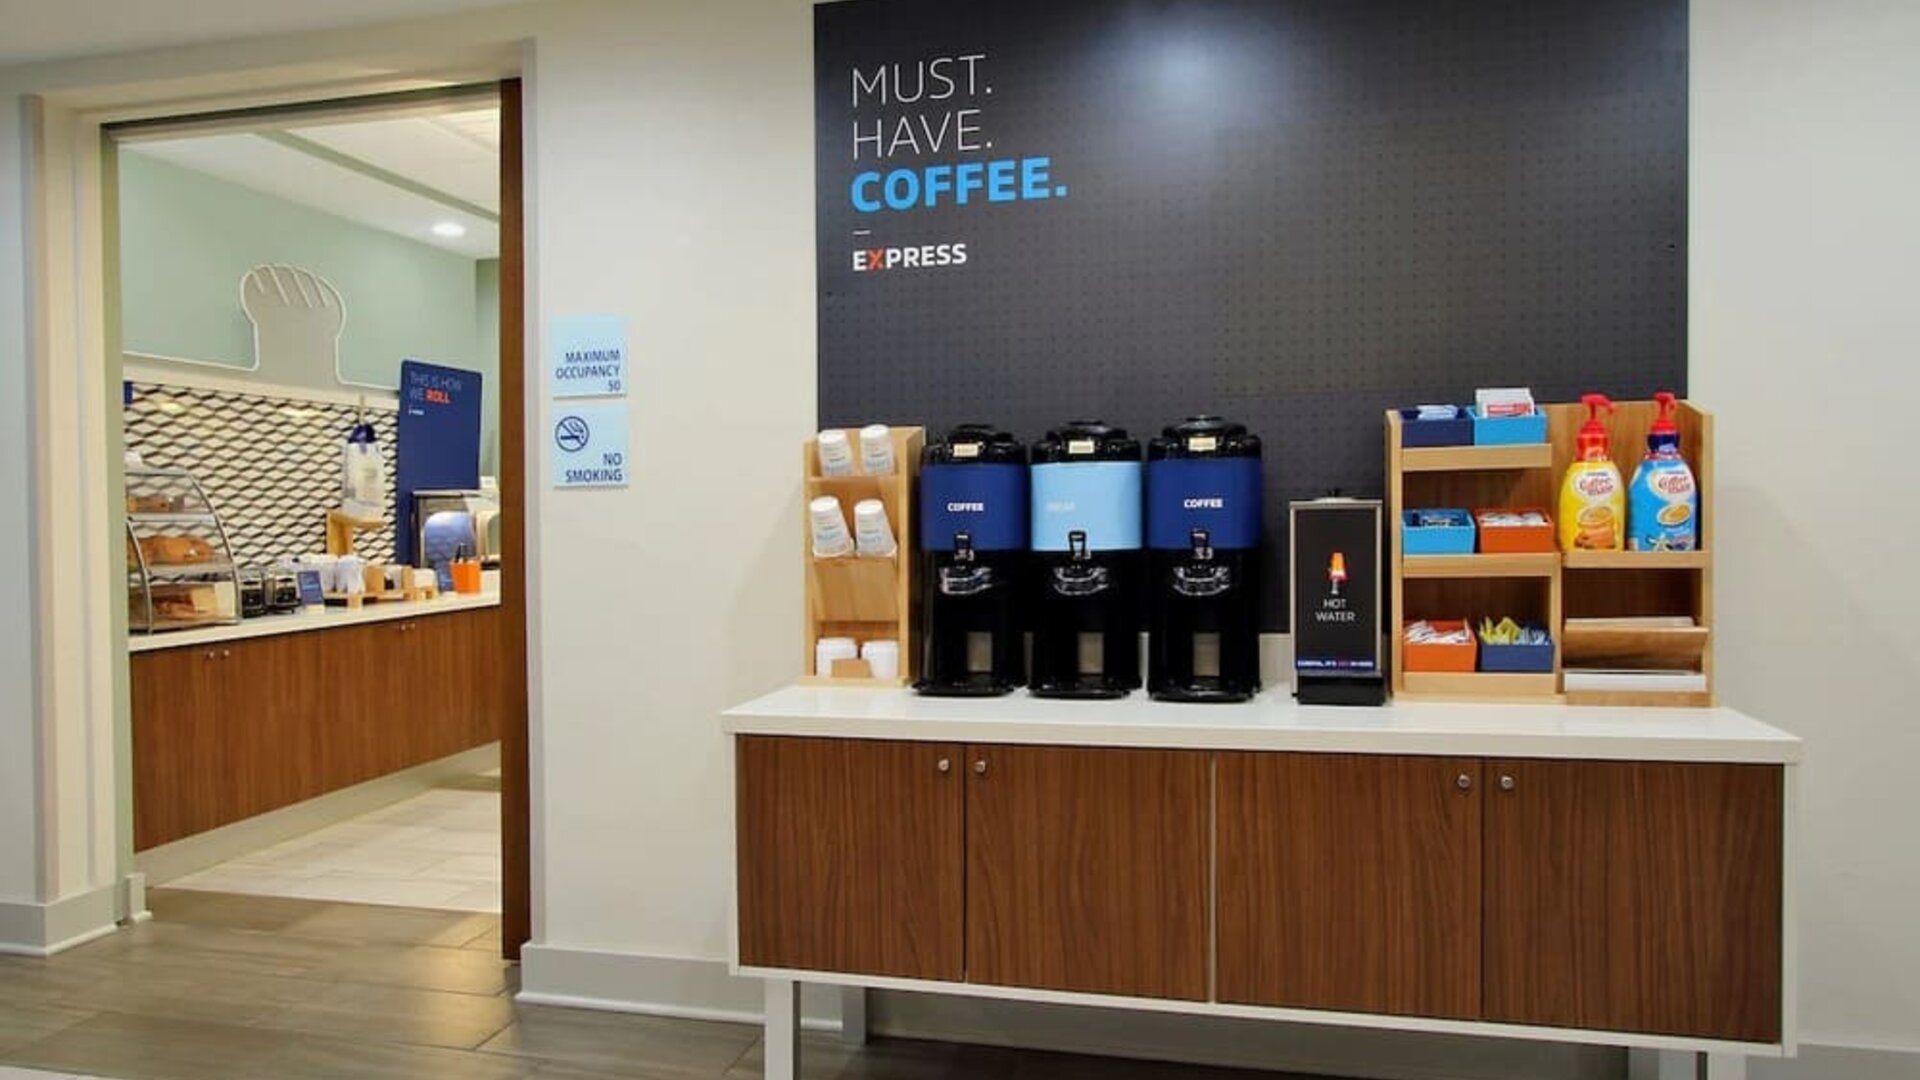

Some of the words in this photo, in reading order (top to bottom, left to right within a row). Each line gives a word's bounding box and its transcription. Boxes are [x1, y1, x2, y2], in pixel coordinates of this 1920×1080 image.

[853, 54, 993, 108] MUST.
[853, 109, 993, 160] HAVE.
[851, 157, 1068, 213] COFFEE.
[852, 243, 967, 271] EXPRESS
[565, 349, 621, 363] MAXIMUM
[555, 364, 621, 380] OCCUPANCY
[608, 380, 621, 392] 50
[426, 389, 452, 404] ROLL
[603, 452, 622, 466] NO
[565, 468, 623, 483] SMOKING
[947, 502, 984, 512] COFFEE
[1184, 498, 1223, 509] COFFEE
[1323, 599, 1347, 609] HOT
[1315, 612, 1356, 622] WATER
